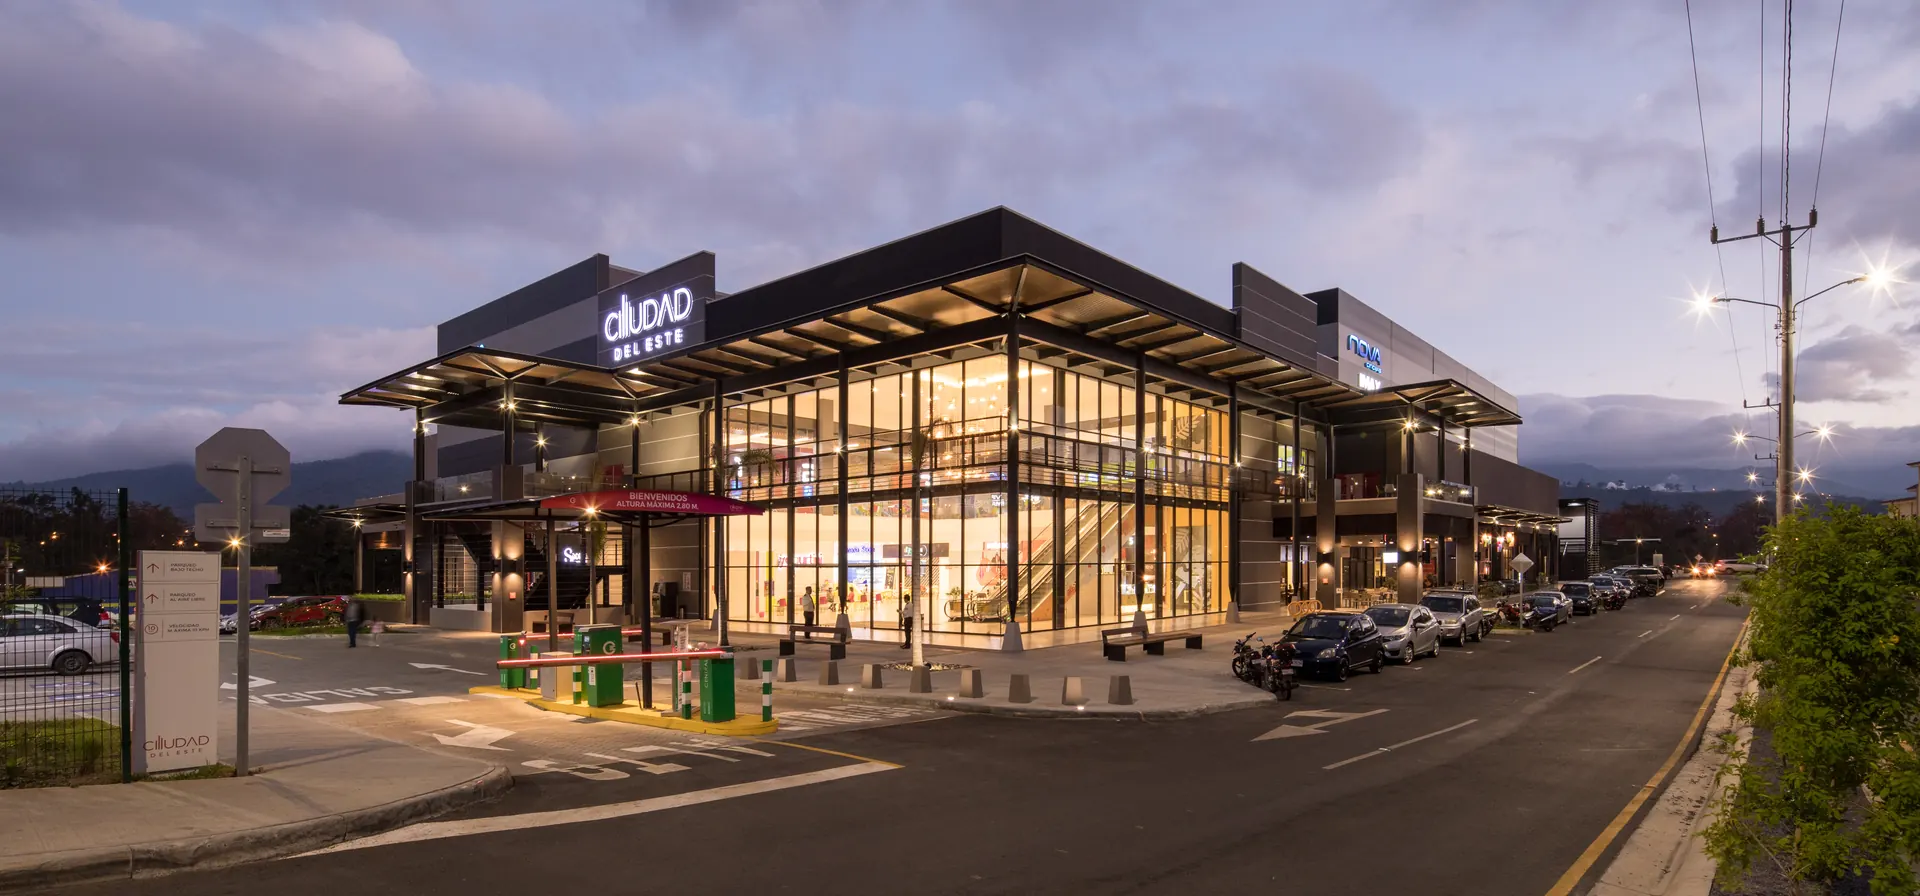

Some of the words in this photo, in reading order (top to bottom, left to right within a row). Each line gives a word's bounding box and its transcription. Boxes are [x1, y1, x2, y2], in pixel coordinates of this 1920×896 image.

[613, 342, 641, 361] DEL
[645, 328, 684, 352] ESTE
[629, 492, 688, 502] BIENVENIDOS
[616, 500, 646, 508] ALTURA
[646, 500, 675, 509] MÁXIMA
[228, 686, 414, 705] SALIDA
[176, 747, 203, 755] ESTE
